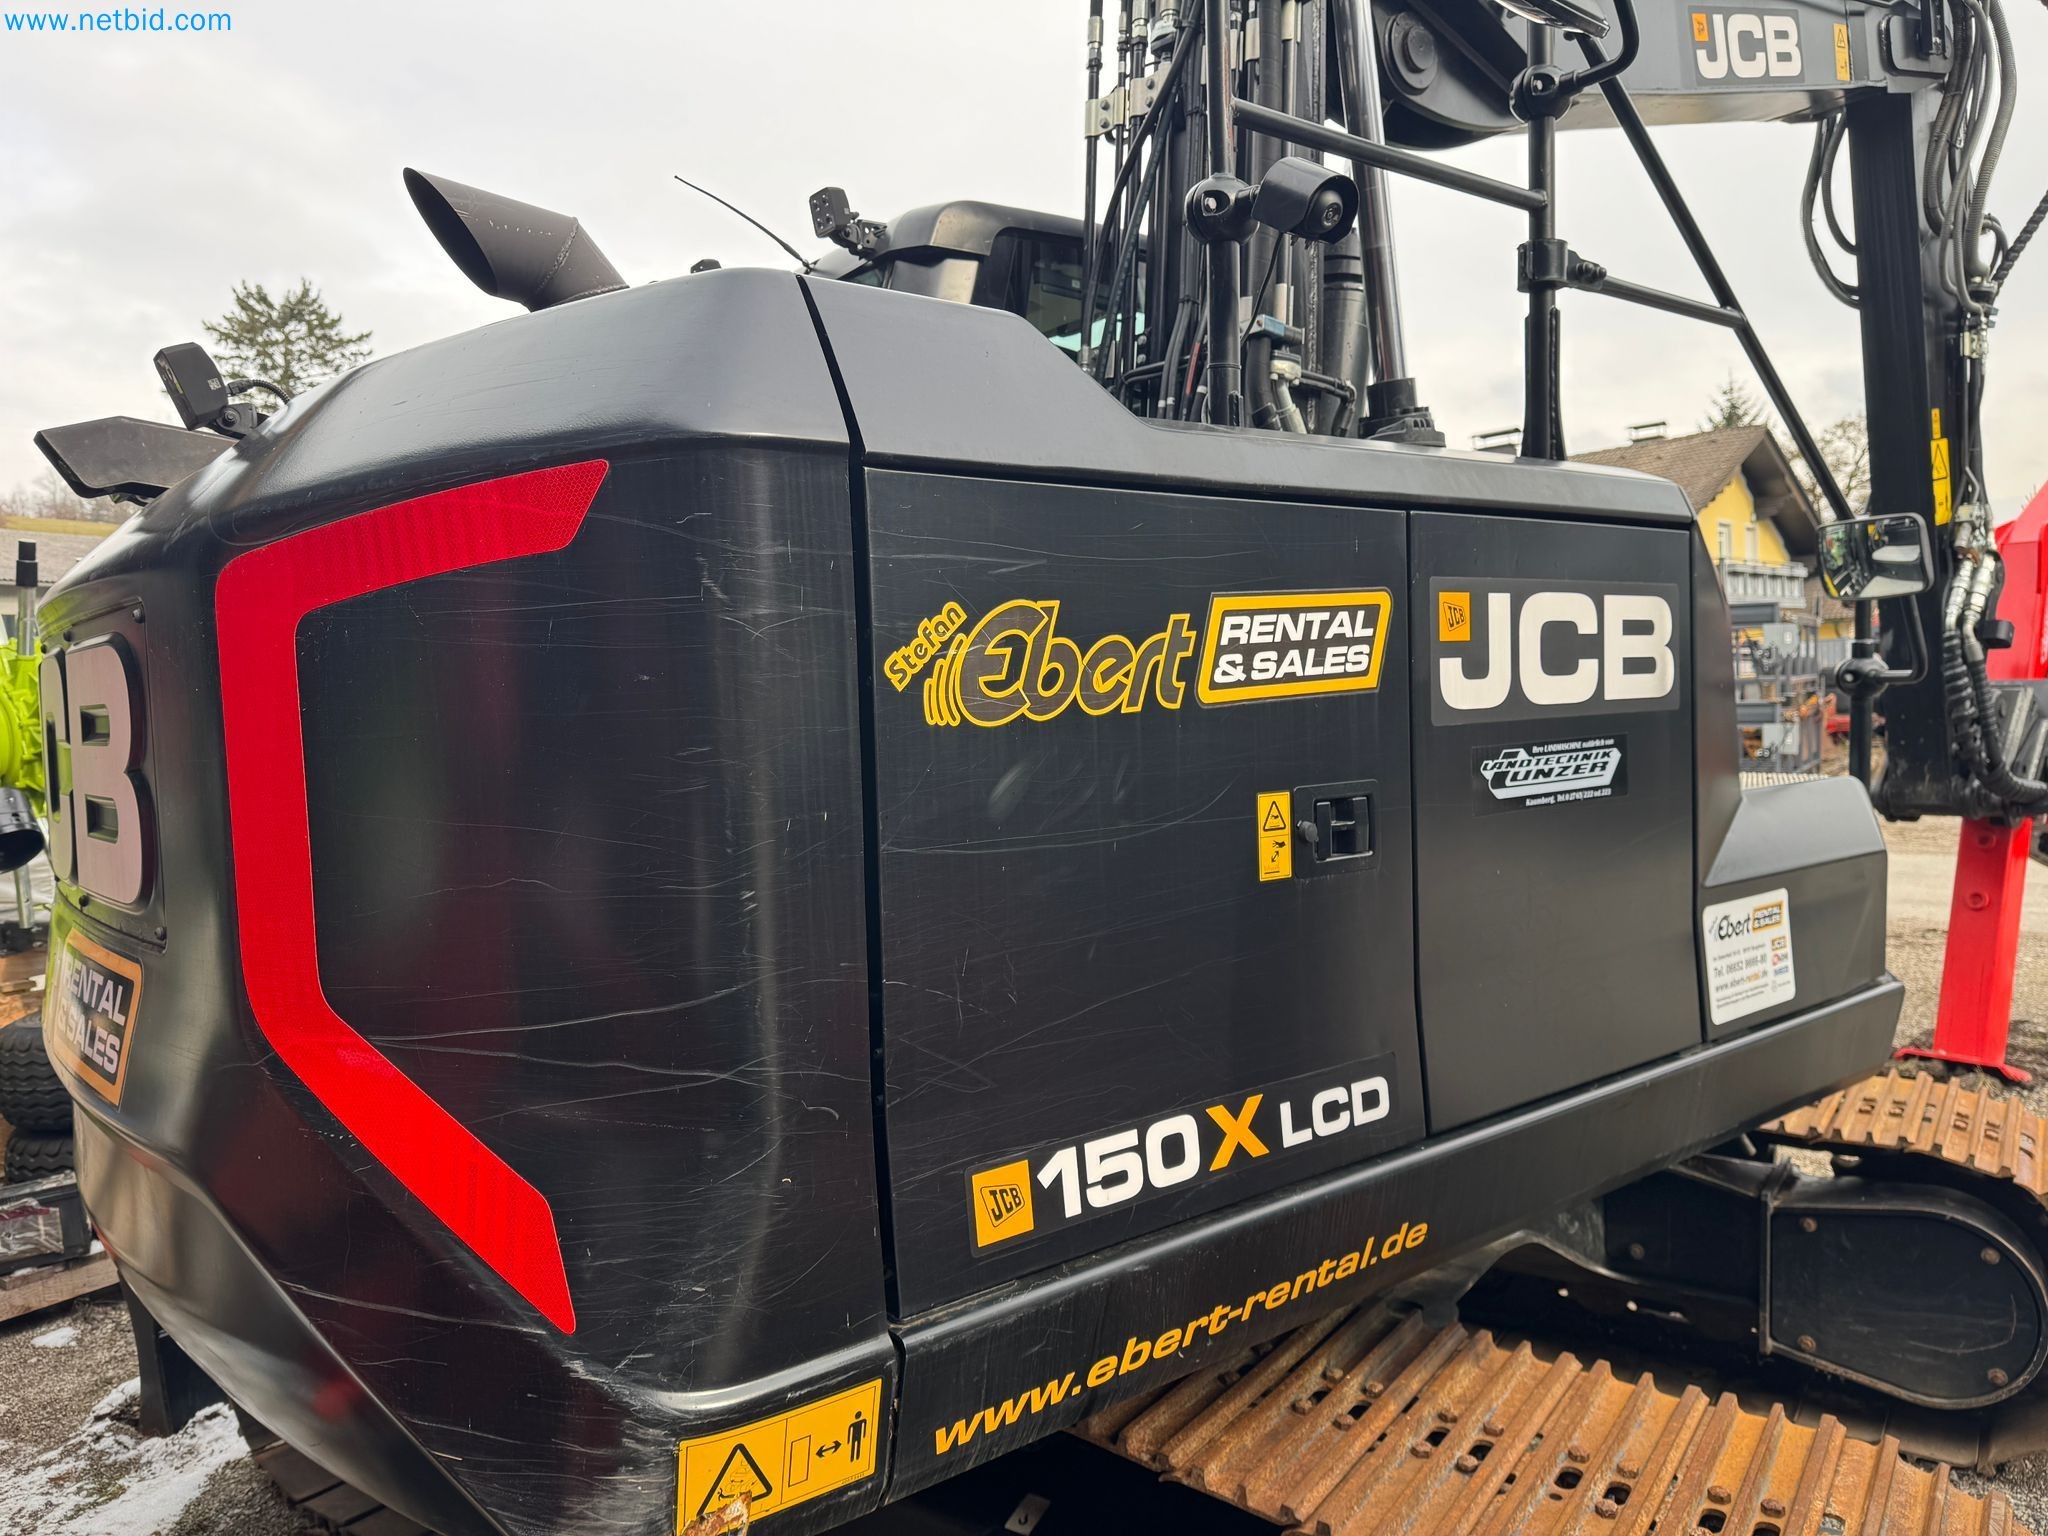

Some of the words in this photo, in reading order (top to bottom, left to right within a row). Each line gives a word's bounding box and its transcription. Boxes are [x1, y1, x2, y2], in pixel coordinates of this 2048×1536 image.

[1696, 13, 1802, 79] JCB
[884, 601, 967, 692] Stefan
[1219, 609, 1374, 646] RENTAL
[1440, 591, 1675, 710] JCB
[1446, 605, 1466, 629] JCB
[957, 598, 1197, 727] Ebert
[1213, 653, 1247, 684] &
[1251, 644, 1370, 681] SALES
[40, 640, 146, 908] CB
[1482, 749, 1613, 772] LANDTECHNIK
[63, 953, 126, 1027] RENTAL
[66, 1009, 121, 1075] SALES
[1279, 1075, 1391, 1149] LCD
[988, 1186, 1022, 1222] JCB
[934, 1220, 1429, 1455] www.ebert-rental.de
